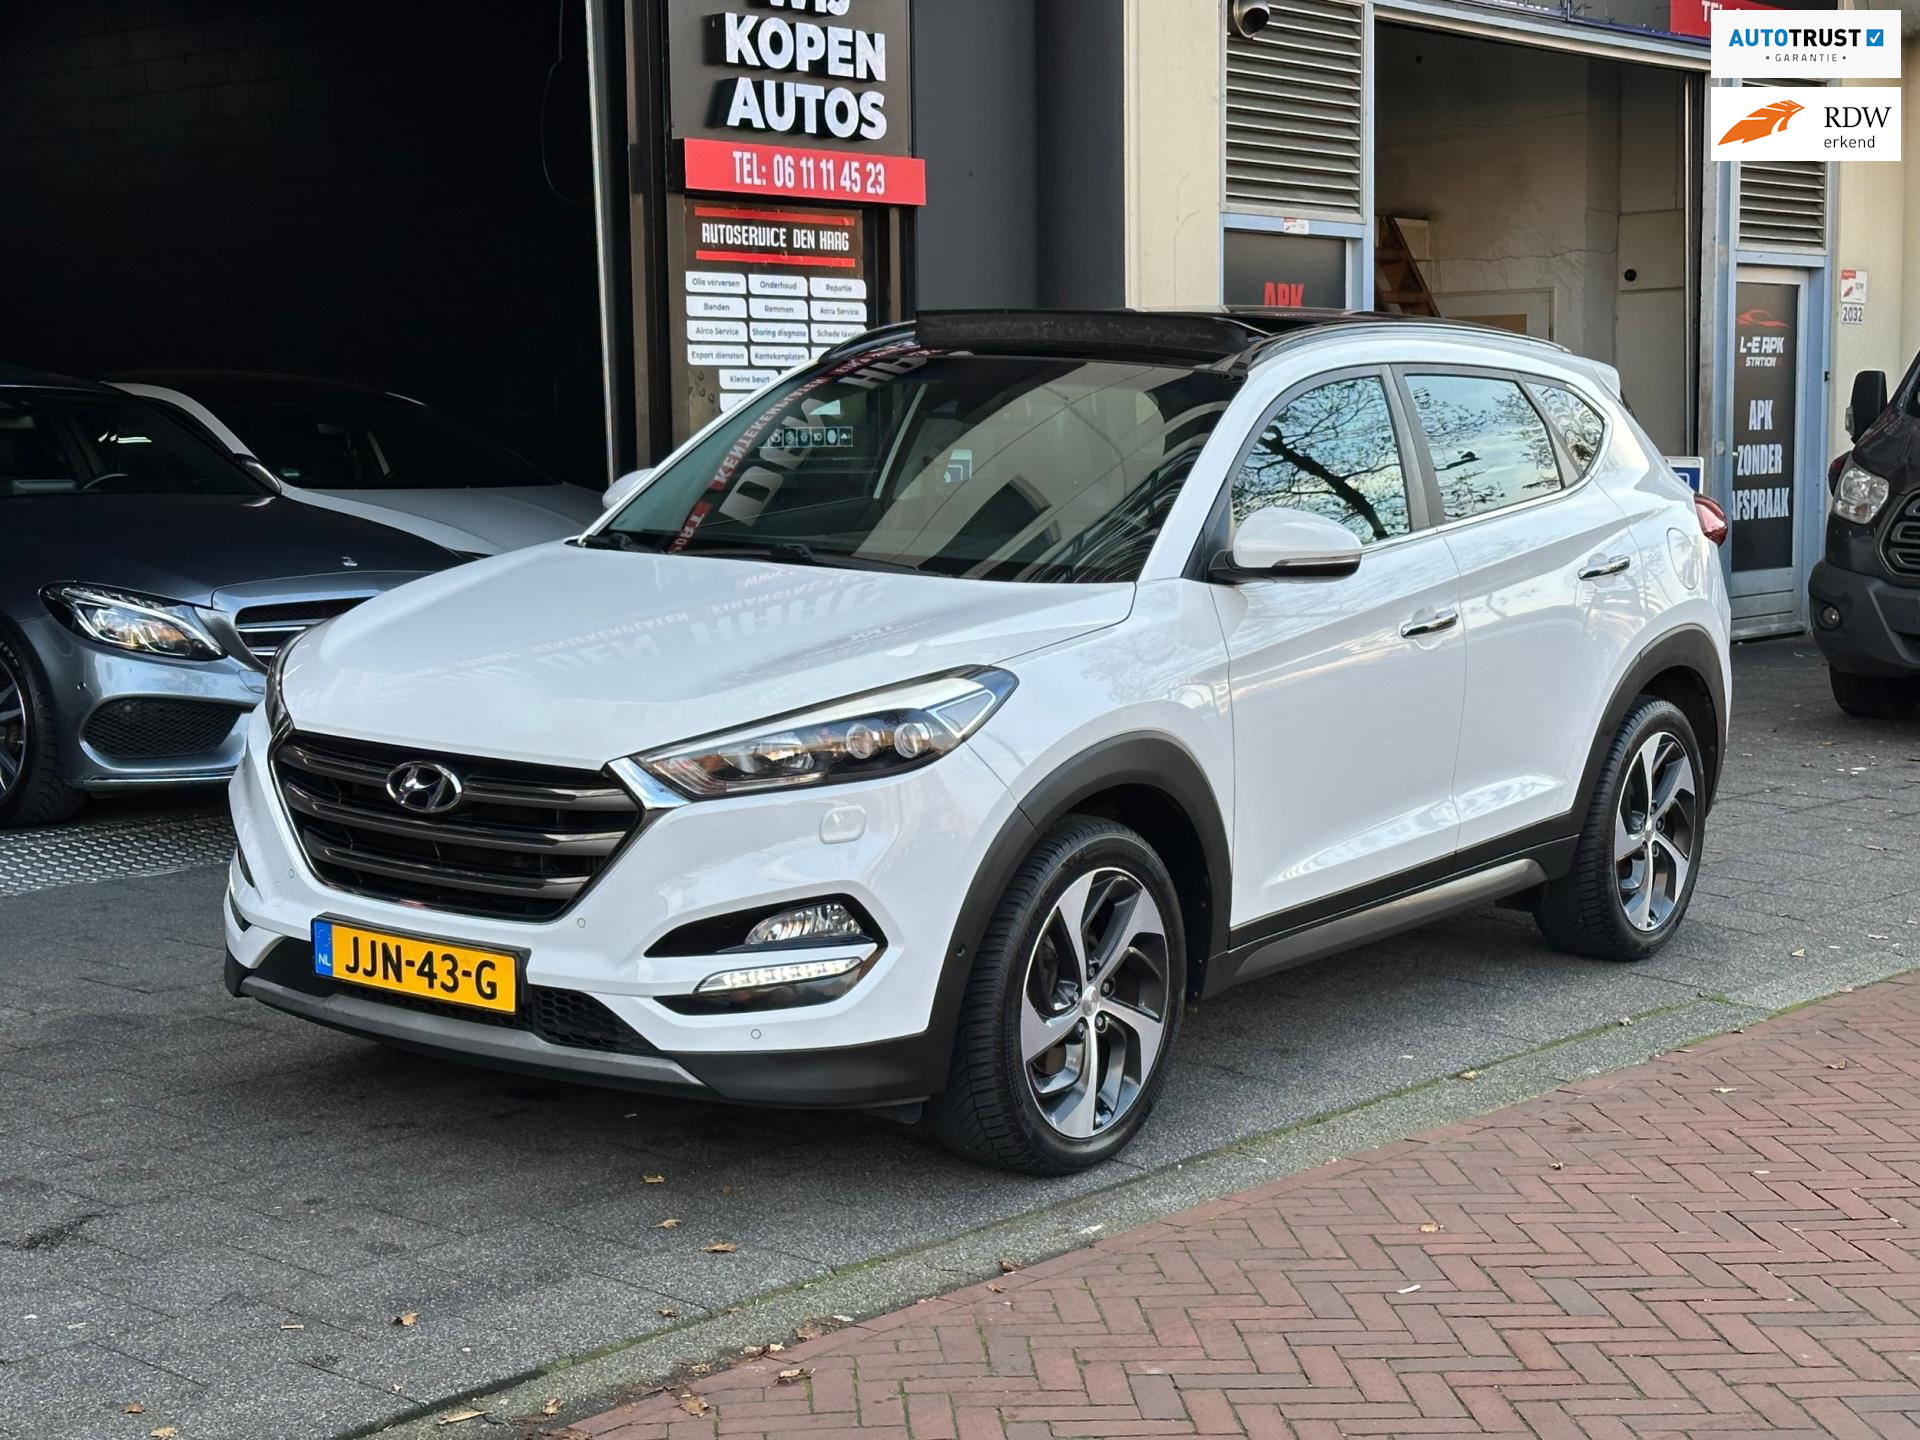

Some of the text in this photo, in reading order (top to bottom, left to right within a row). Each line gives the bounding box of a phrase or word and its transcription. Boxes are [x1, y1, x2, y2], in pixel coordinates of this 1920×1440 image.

[725, 12, 886, 82] KOPEN
[726, 76, 888, 140] AUTOS
[732, 150, 885, 195] TEL: 06 11 11 45 23
[701, 223, 850, 251] AUTOSERVICE DEN HAAG
[759, 280, 798, 290] Onderhoud
[703, 302, 730, 311] Banden
[764, 304, 794, 313] Remmen
[819, 306, 860, 316] Accu Service
[1842, 306, 1863, 322] 2032
[695, 327, 740, 336] Airco Service
[1761, 336, 1785, 354] APK
[1745, 356, 1777, 367] STATION
[1748, 399, 1774, 431] APK
[1736, 443, 1783, 476] ZONDER
[317, 936, 498, 1001] NL JJN-43-G
